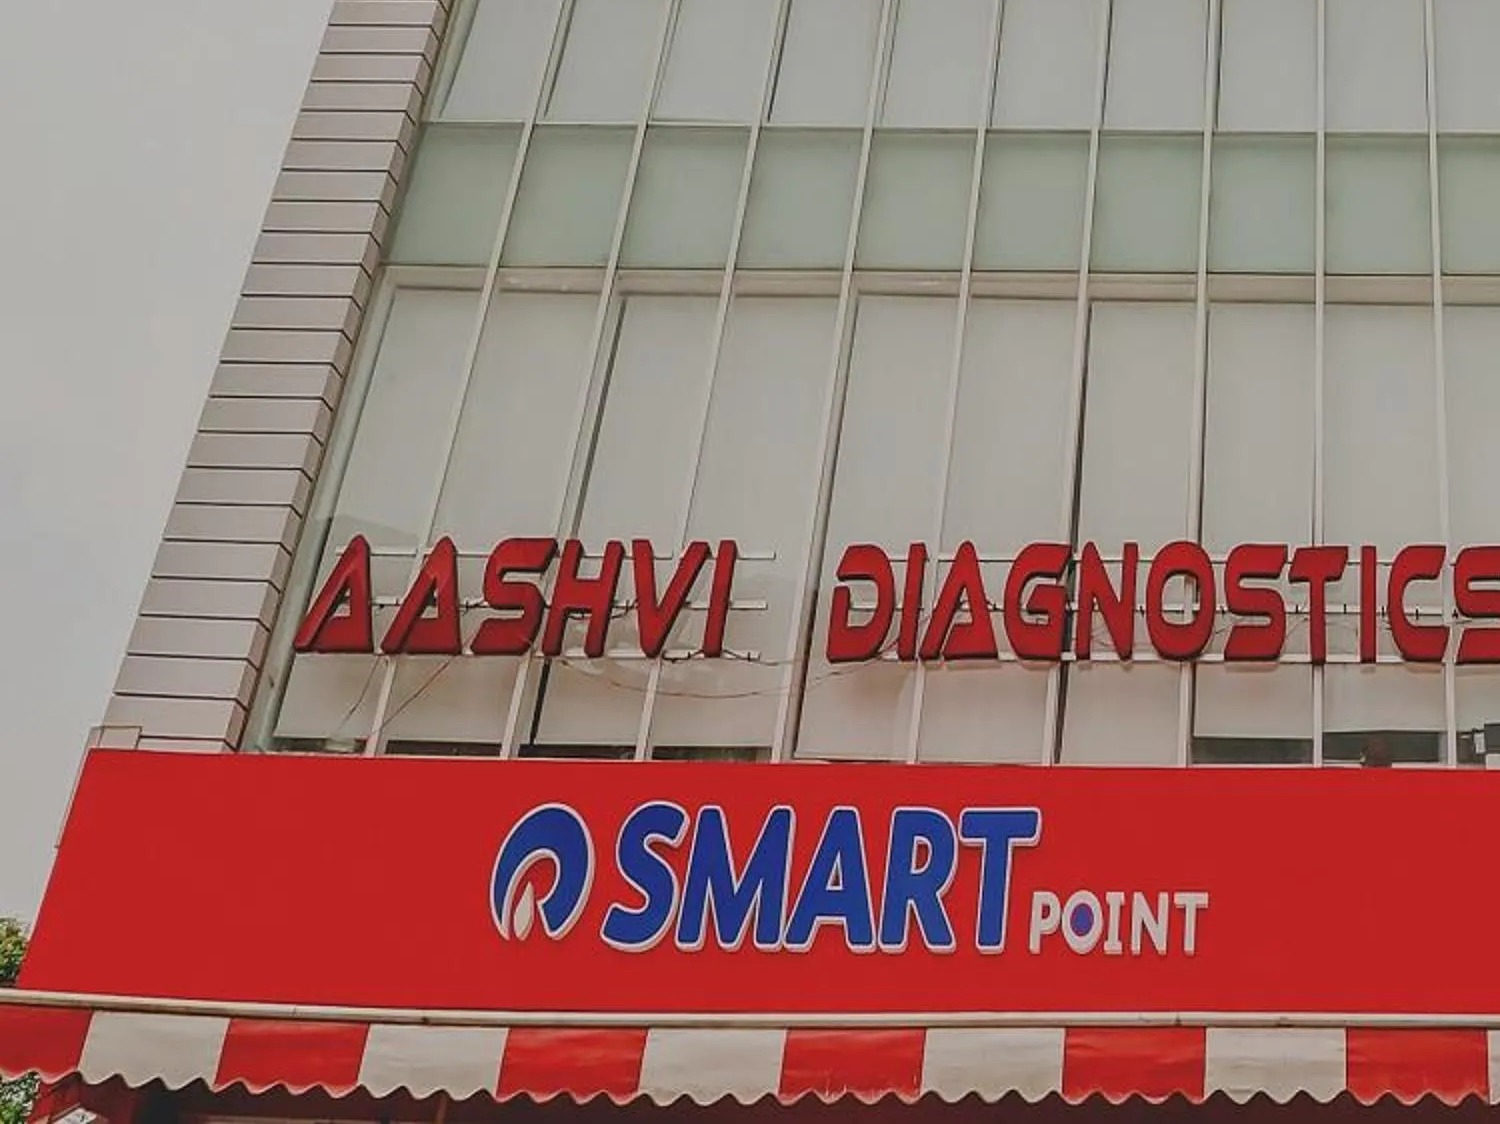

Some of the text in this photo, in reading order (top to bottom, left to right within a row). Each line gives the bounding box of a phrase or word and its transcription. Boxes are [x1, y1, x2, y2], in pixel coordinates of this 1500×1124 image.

[294, 533, 738, 659] AASHVI
[601, 801, 1209, 956] SMART POINT
